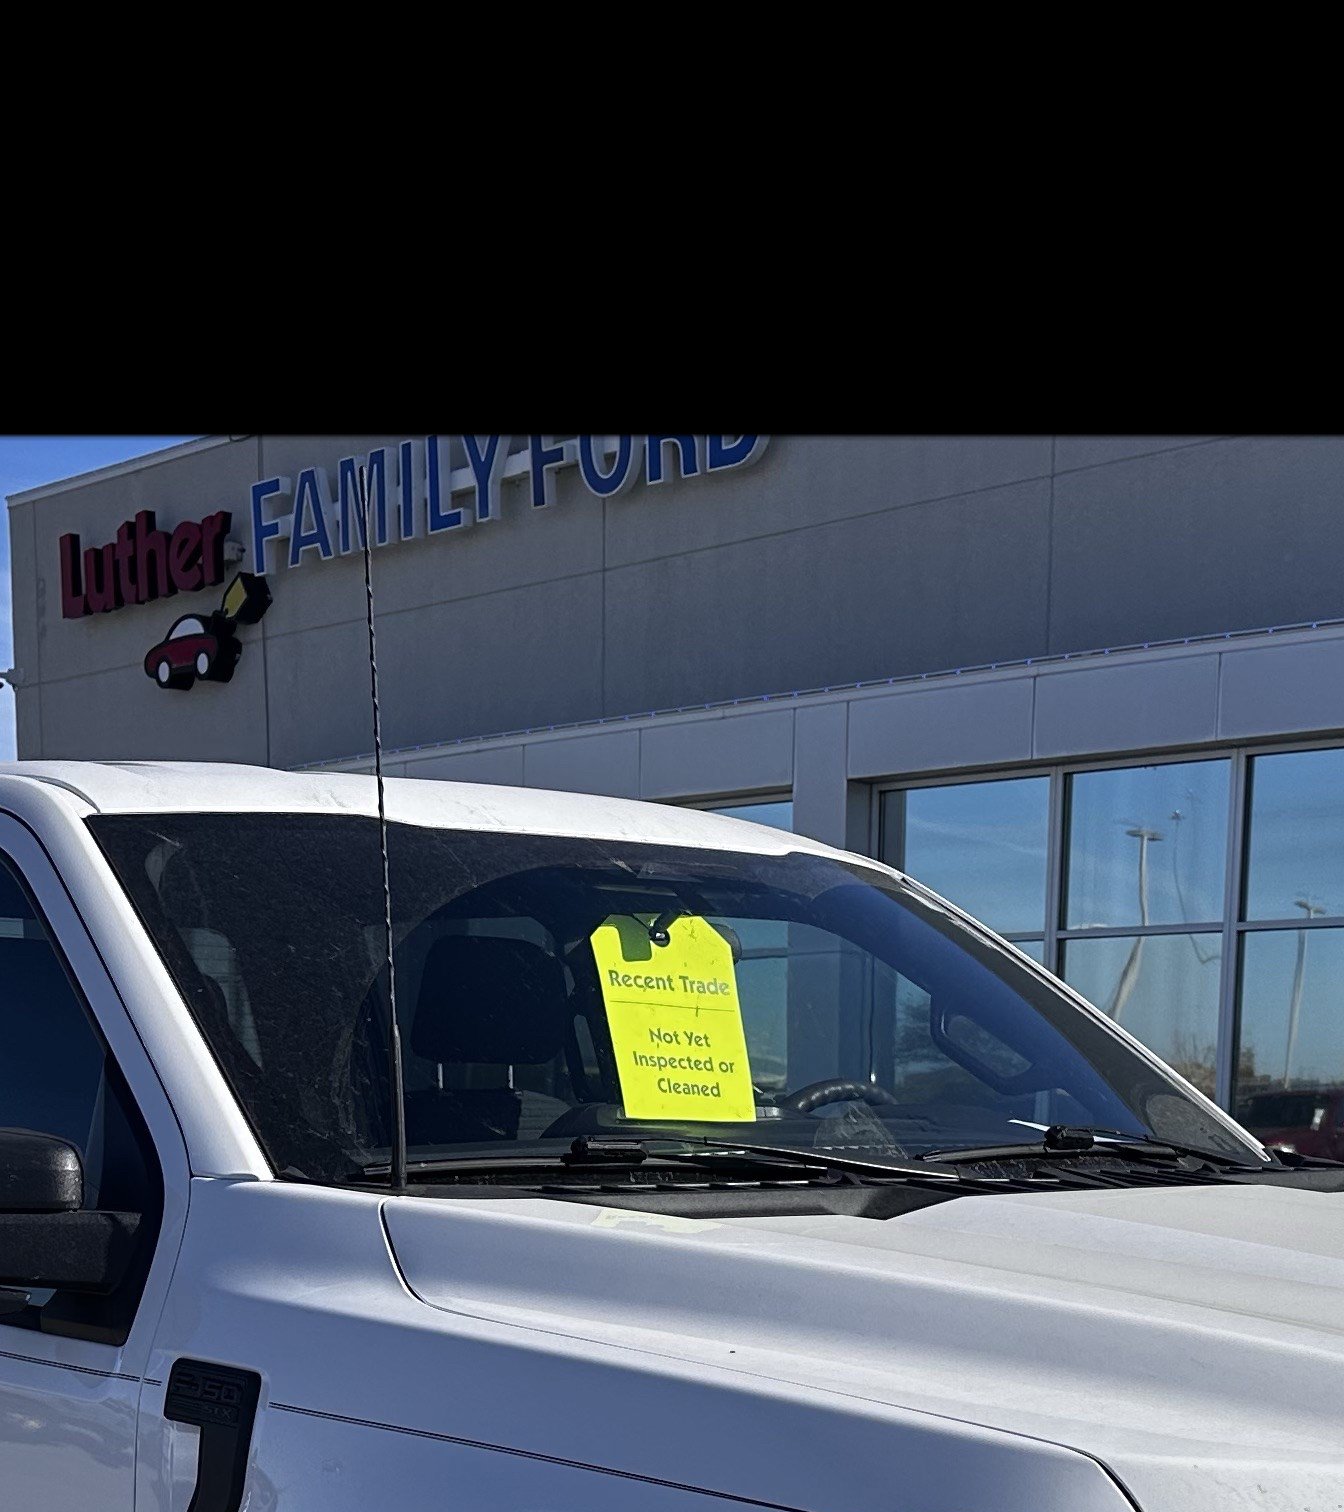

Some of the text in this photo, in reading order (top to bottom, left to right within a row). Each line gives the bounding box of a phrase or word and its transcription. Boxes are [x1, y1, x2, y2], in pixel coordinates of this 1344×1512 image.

[251, 434, 501, 577] FAMILY
[60, 510, 232, 619] Luther
[608, 969, 731, 996] Recent Trade
[648, 1027, 712, 1048] Not Yet
[632, 1051, 735, 1074] Inspected or
[657, 1077, 722, 1098] Cleaned
